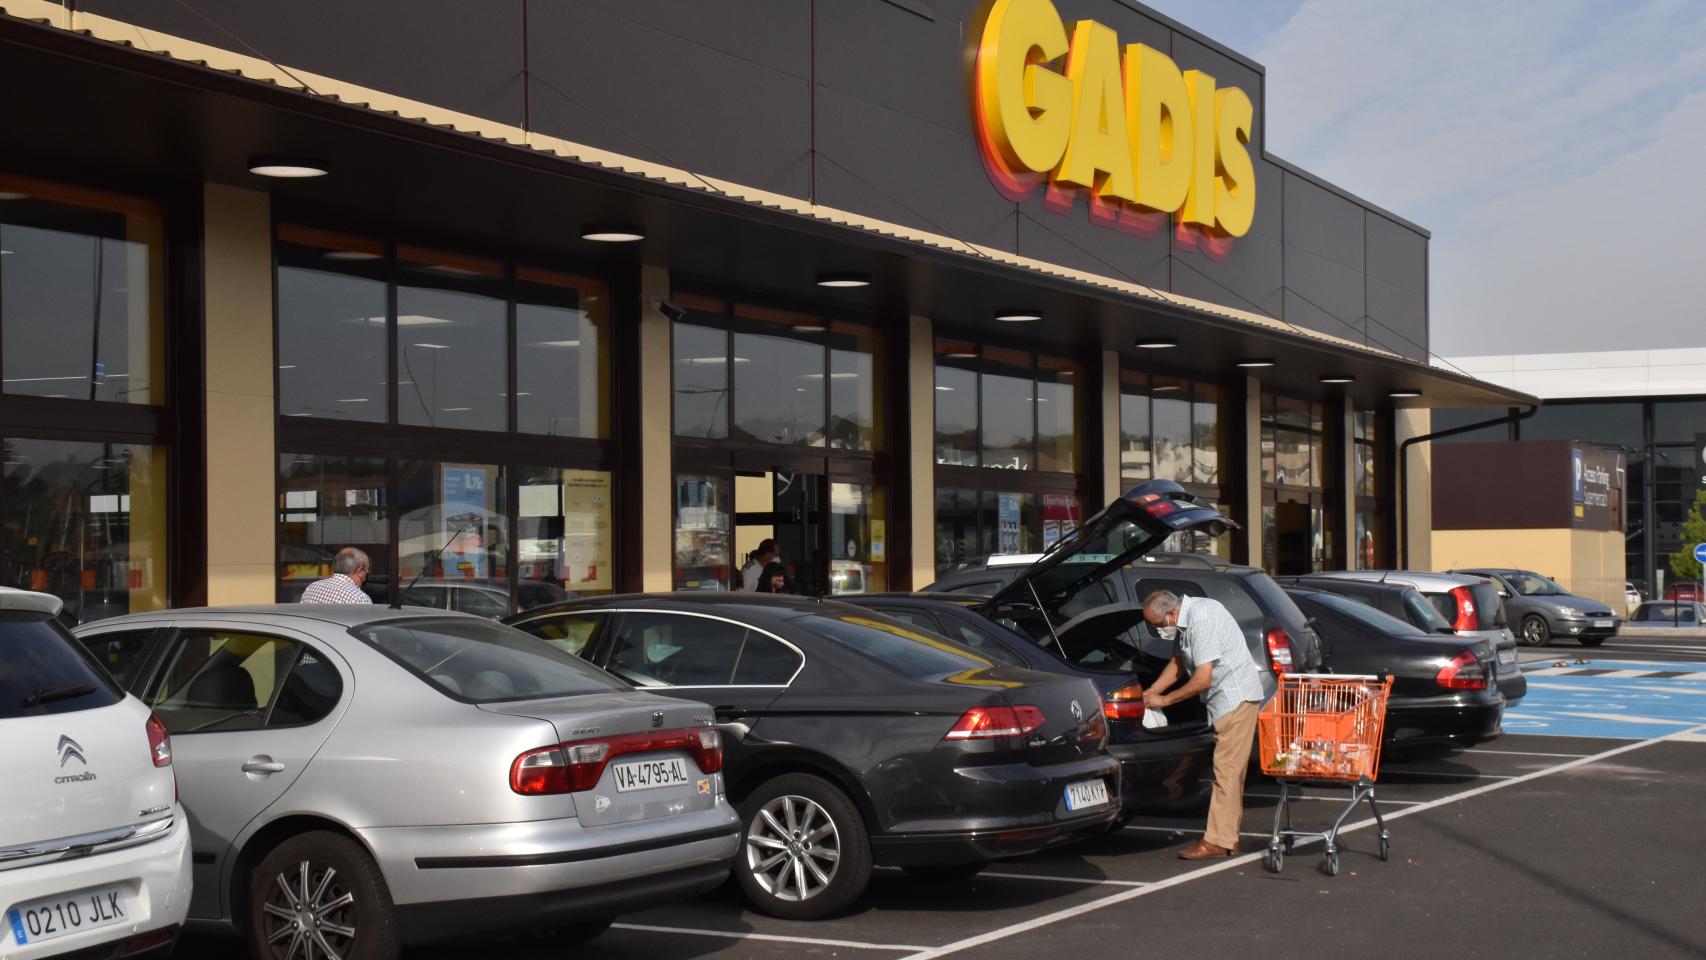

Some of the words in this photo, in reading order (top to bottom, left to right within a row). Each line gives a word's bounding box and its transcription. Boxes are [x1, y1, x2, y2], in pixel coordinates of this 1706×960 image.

[979, 0, 1256, 238] GADIS
[615, 760, 687, 789] VA-4795-AL
[26, 901, 81, 936] 0210
[89, 891, 125, 923] JLK
